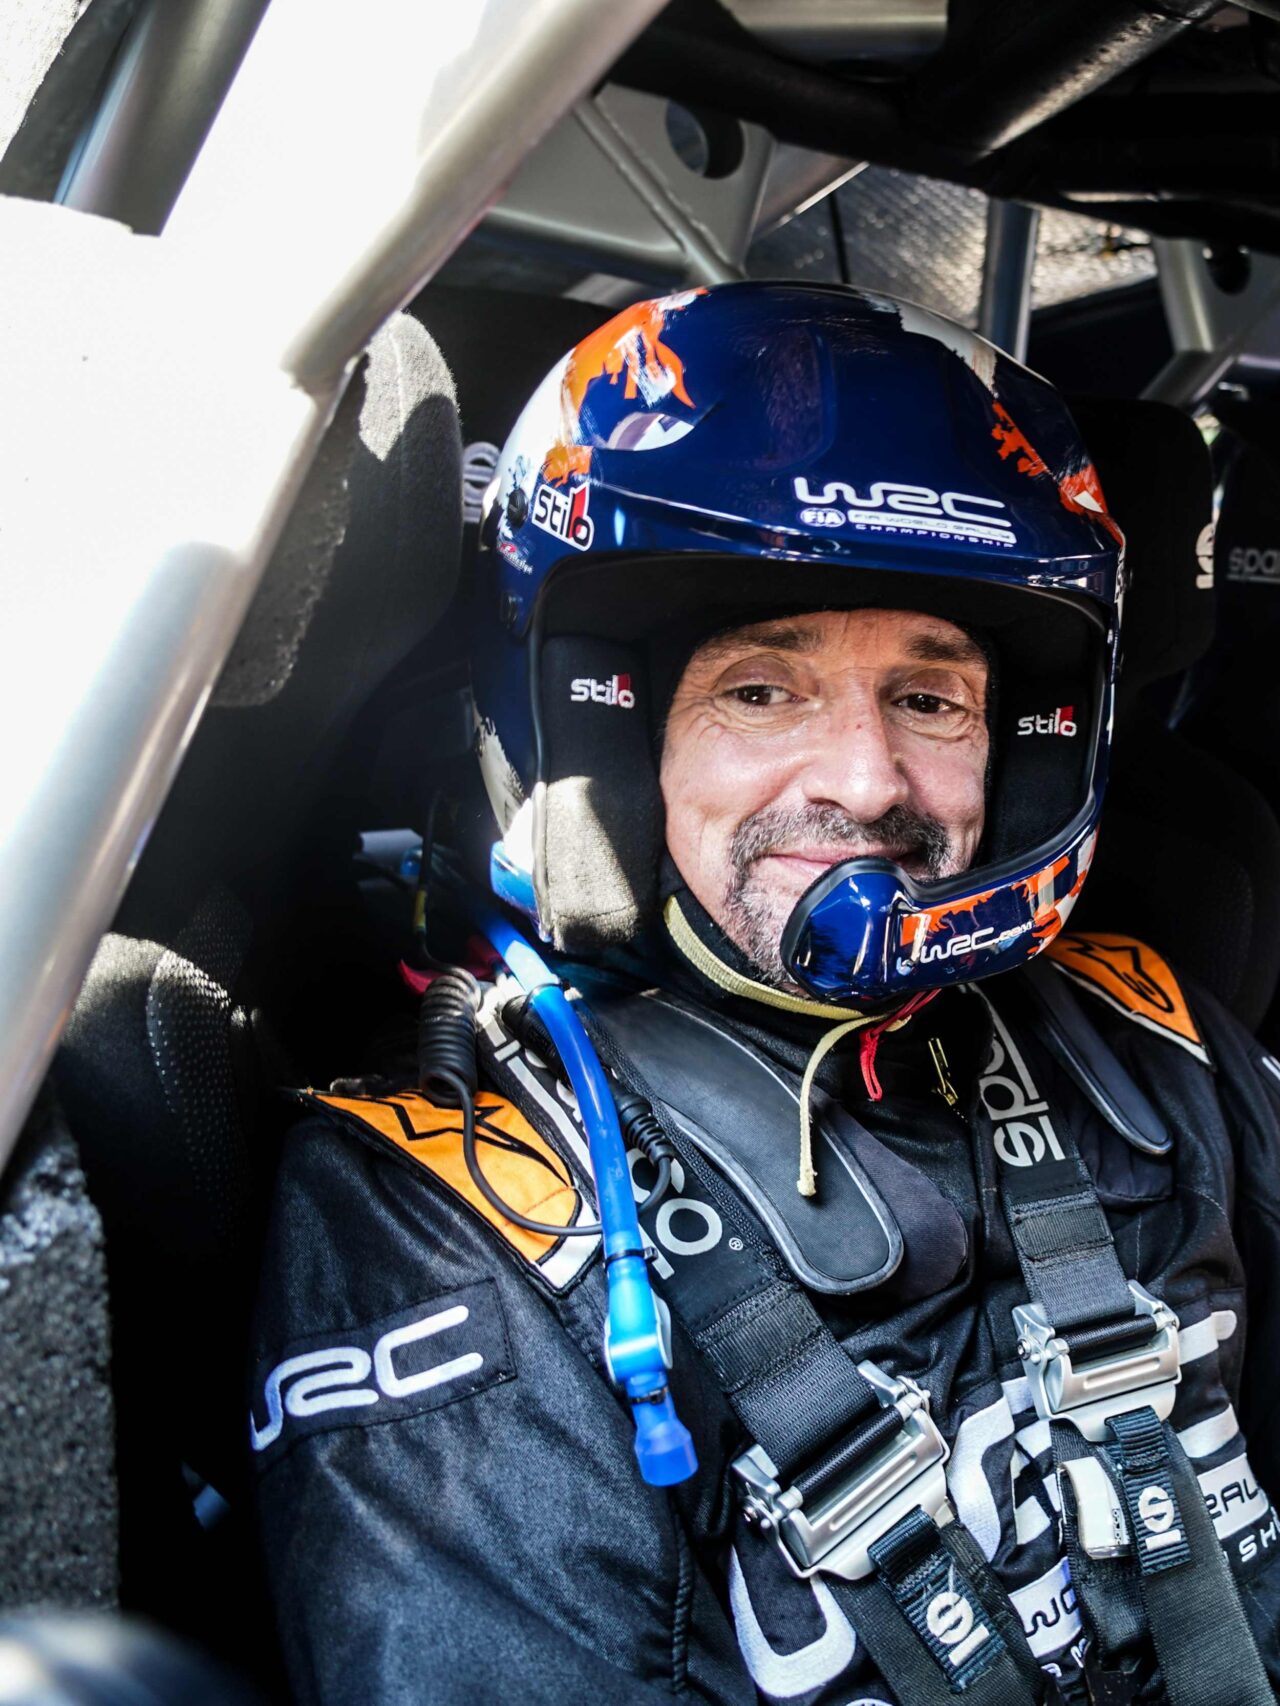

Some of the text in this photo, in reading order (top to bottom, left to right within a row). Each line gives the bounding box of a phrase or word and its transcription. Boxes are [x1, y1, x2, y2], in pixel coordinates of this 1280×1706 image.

[794, 477, 1012, 528] WRC
[803, 511, 842, 525] FIA
[855, 524, 1014, 548] CHAMPIONSHIP
